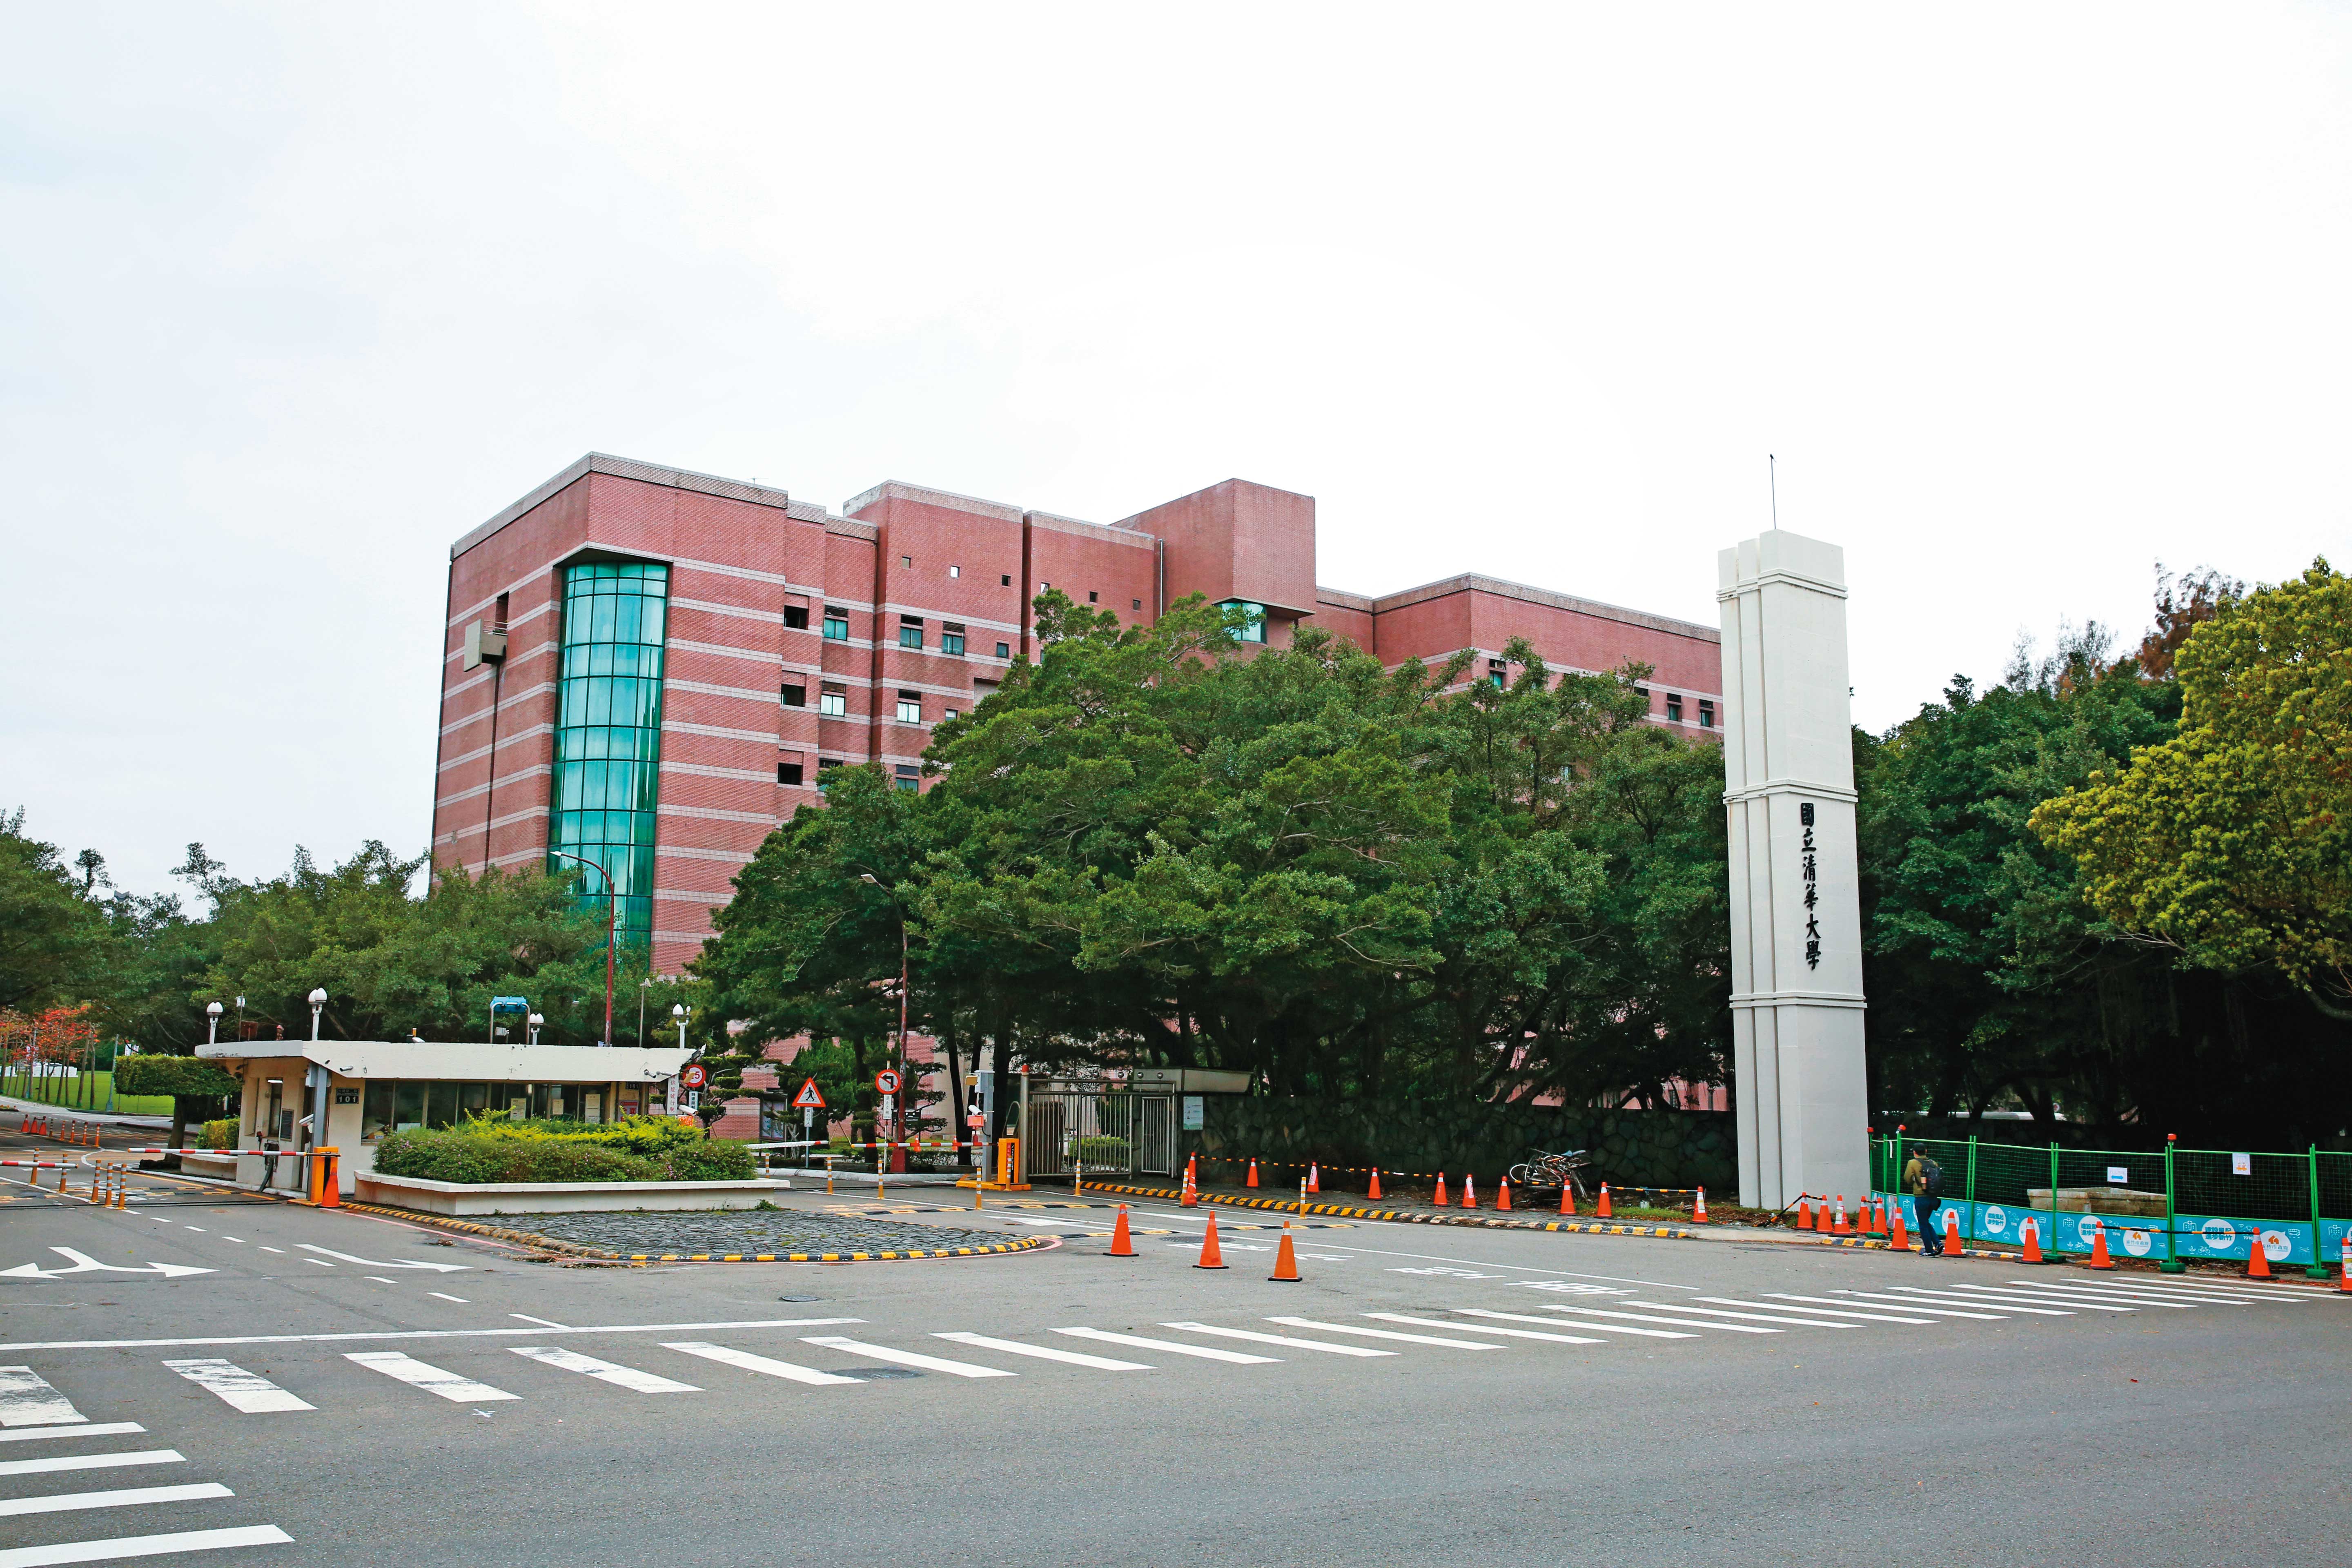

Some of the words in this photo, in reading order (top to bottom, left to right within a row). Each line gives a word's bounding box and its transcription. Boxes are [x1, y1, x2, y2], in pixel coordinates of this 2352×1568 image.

[1801, 802, 1821, 971] 國立清華大學
